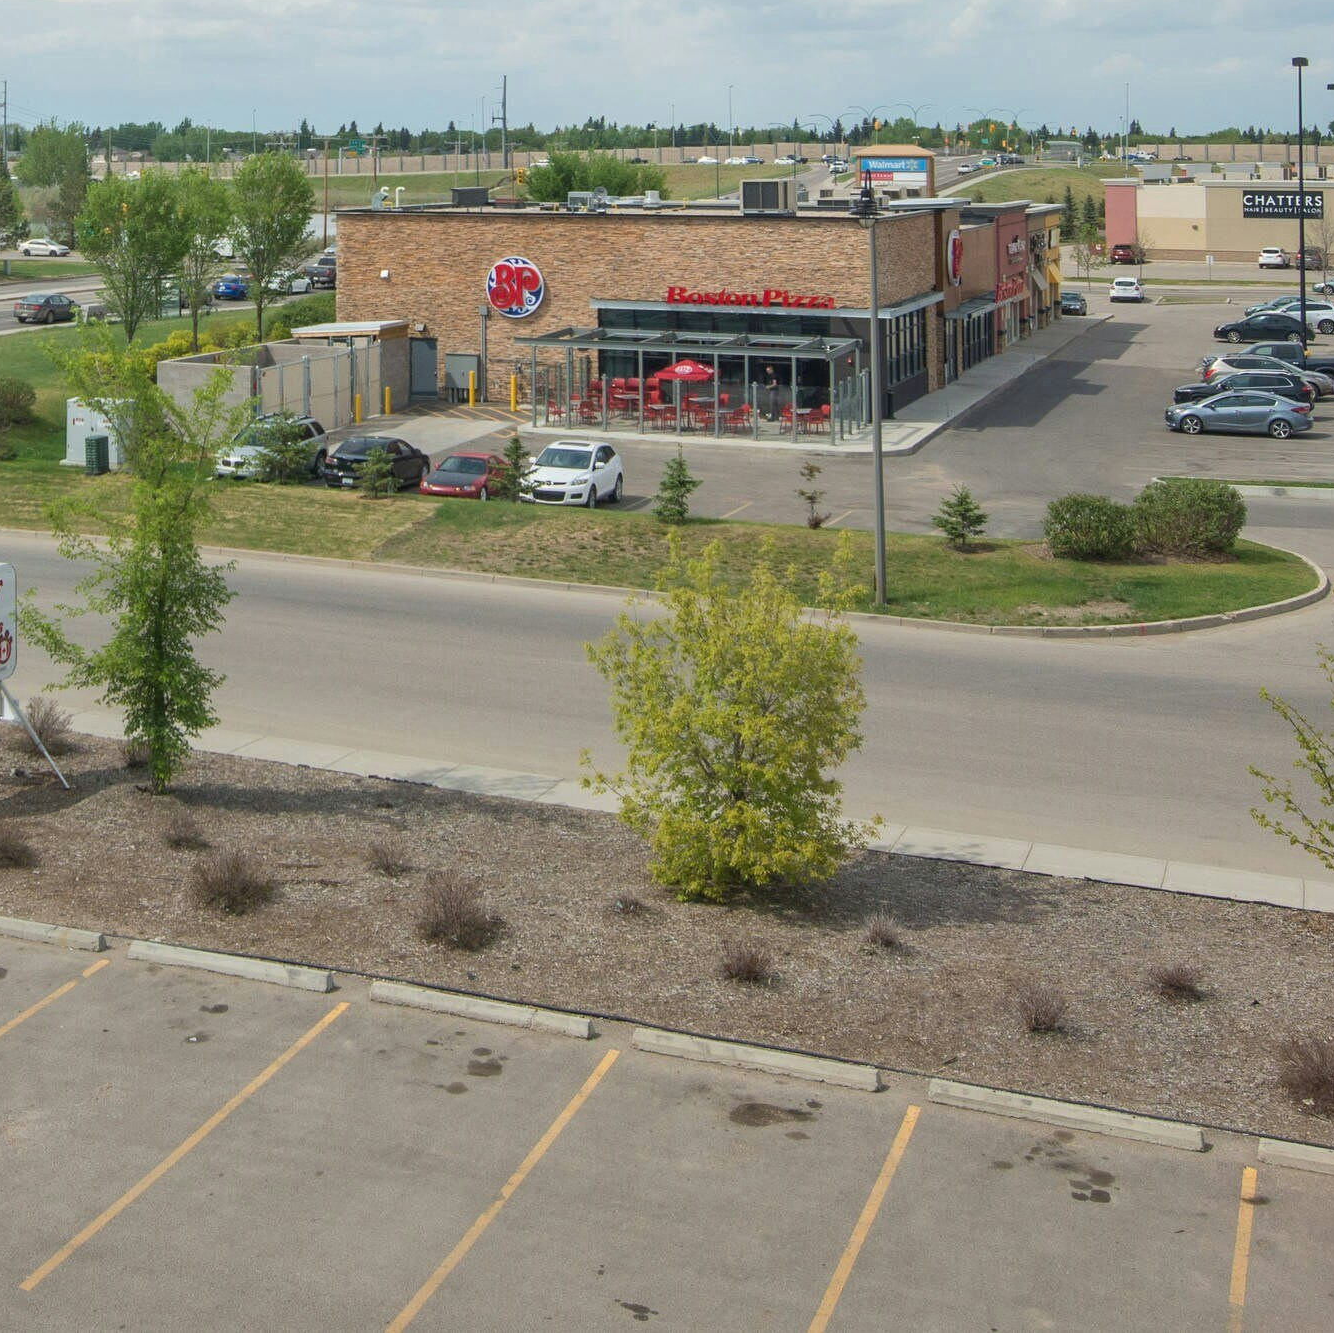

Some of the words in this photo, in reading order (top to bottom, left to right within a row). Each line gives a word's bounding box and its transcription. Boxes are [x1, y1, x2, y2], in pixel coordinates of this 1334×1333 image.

[868, 159, 905, 169] Walmart
[1243, 195, 1323, 206] CHATTERS
[489, 263, 541, 310] BP
[666, 286, 758, 307] Boston
[762, 289, 835, 310] Pizza
